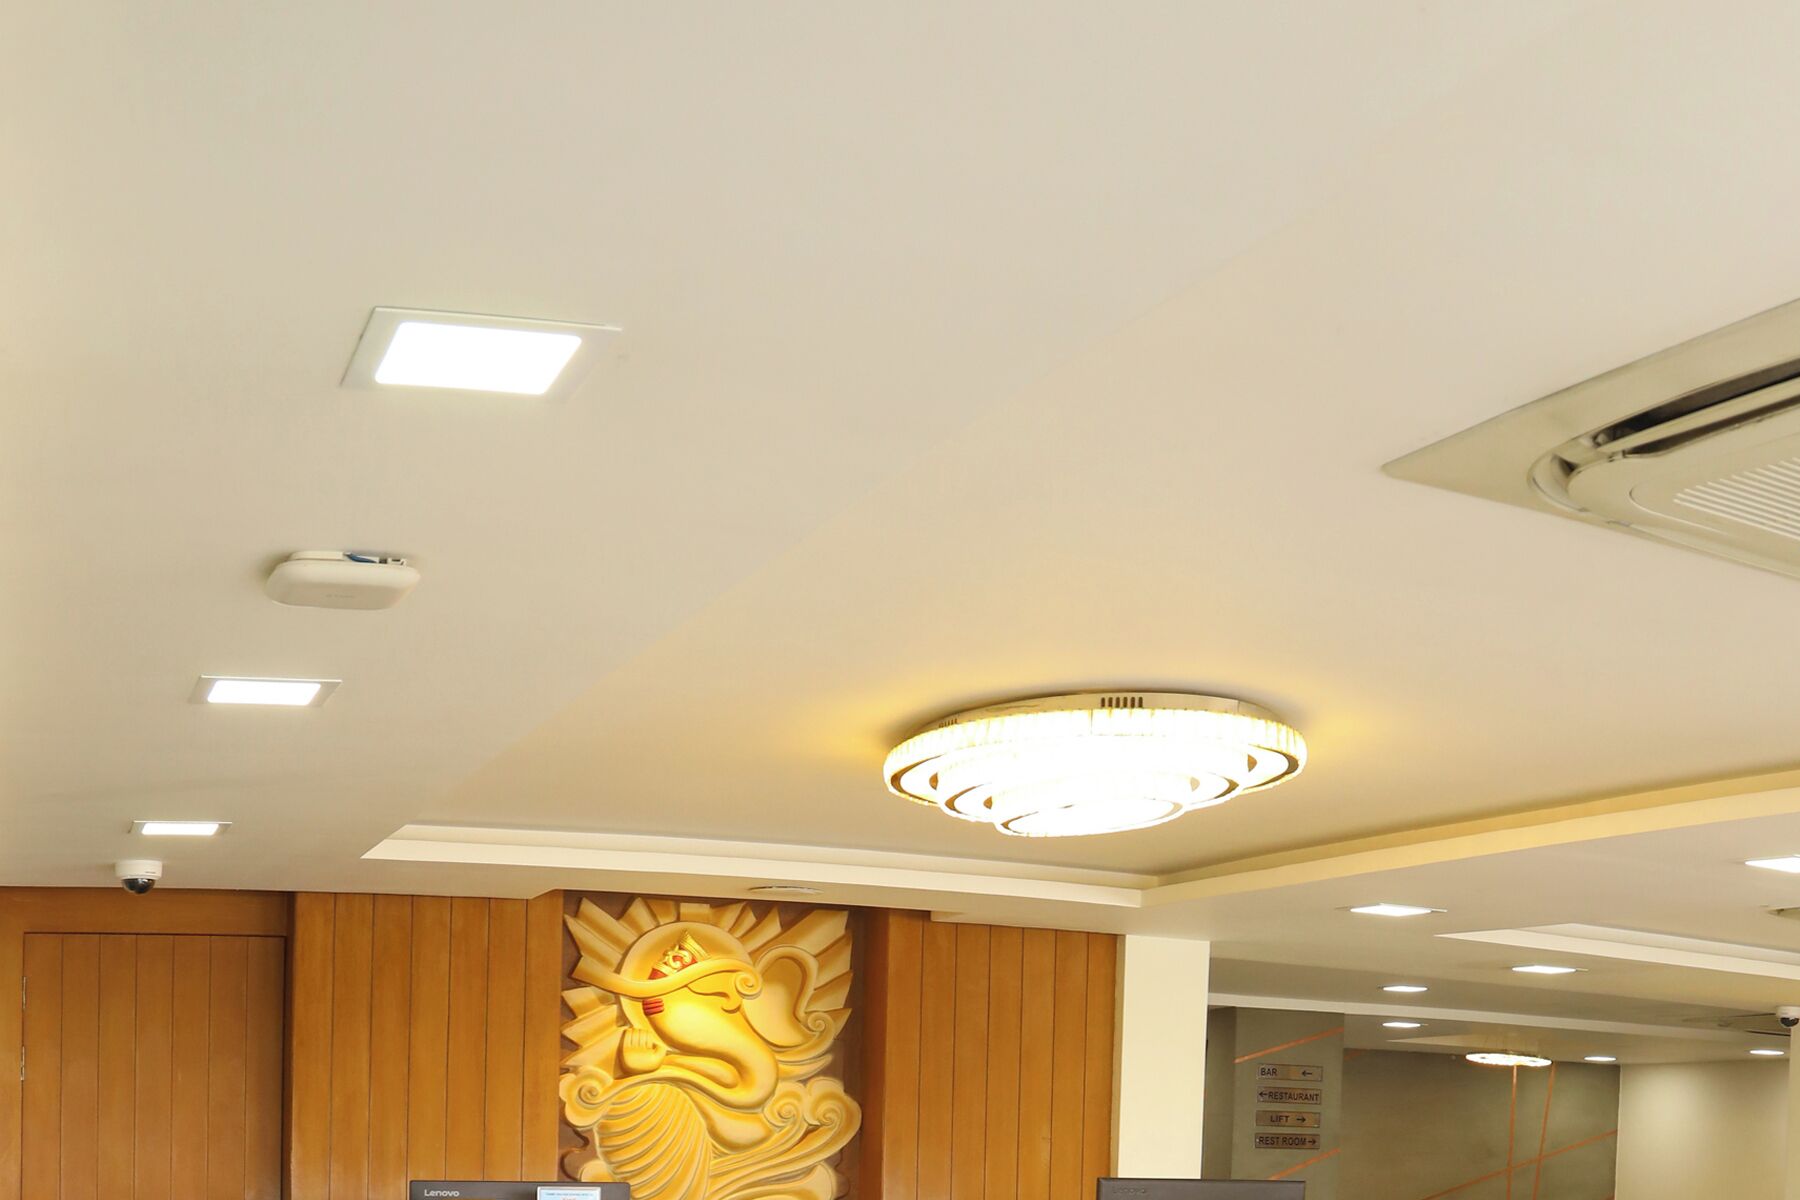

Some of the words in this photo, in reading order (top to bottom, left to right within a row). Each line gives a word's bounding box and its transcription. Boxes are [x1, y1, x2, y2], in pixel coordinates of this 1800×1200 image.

[1260, 1068, 1278, 1076] BAR
[1268, 1089, 1320, 1102] RESTAURANT
[1270, 1114, 1290, 1123] LIFT
[1258, 1137, 1279, 1145] REST
[1281, 1136, 1307, 1146] ROOM
[424, 1189, 460, 1197] Lenovo
